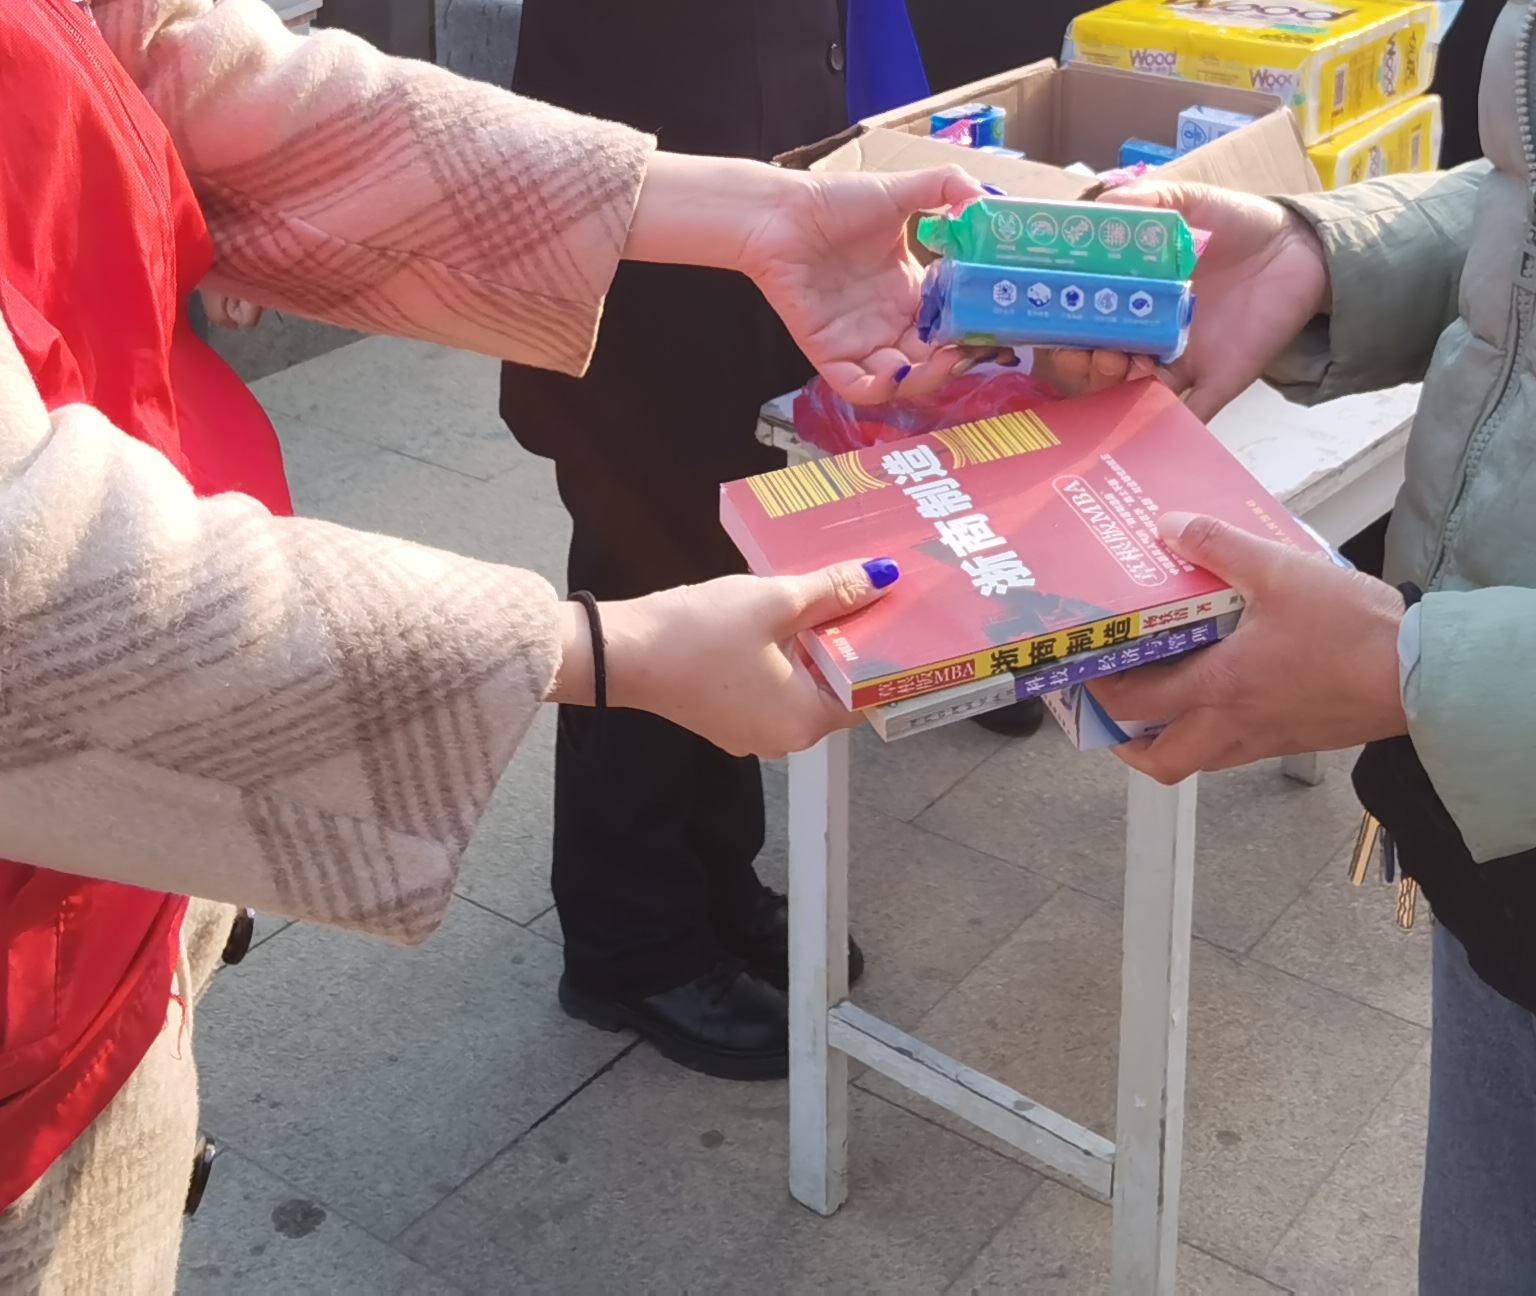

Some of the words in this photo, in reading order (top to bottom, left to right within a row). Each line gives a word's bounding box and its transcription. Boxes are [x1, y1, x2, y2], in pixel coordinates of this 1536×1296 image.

[1129, 47, 1178, 67] Wood
[881, 445, 1035, 596] 浙商制造
[1064, 480, 1158, 584] 草根版MBA
[990, 617, 1132, 675] 浙商制造
[1025, 623, 1210, 694] 科技、经济与管理
[878, 661, 976, 698] 草根版MBA
